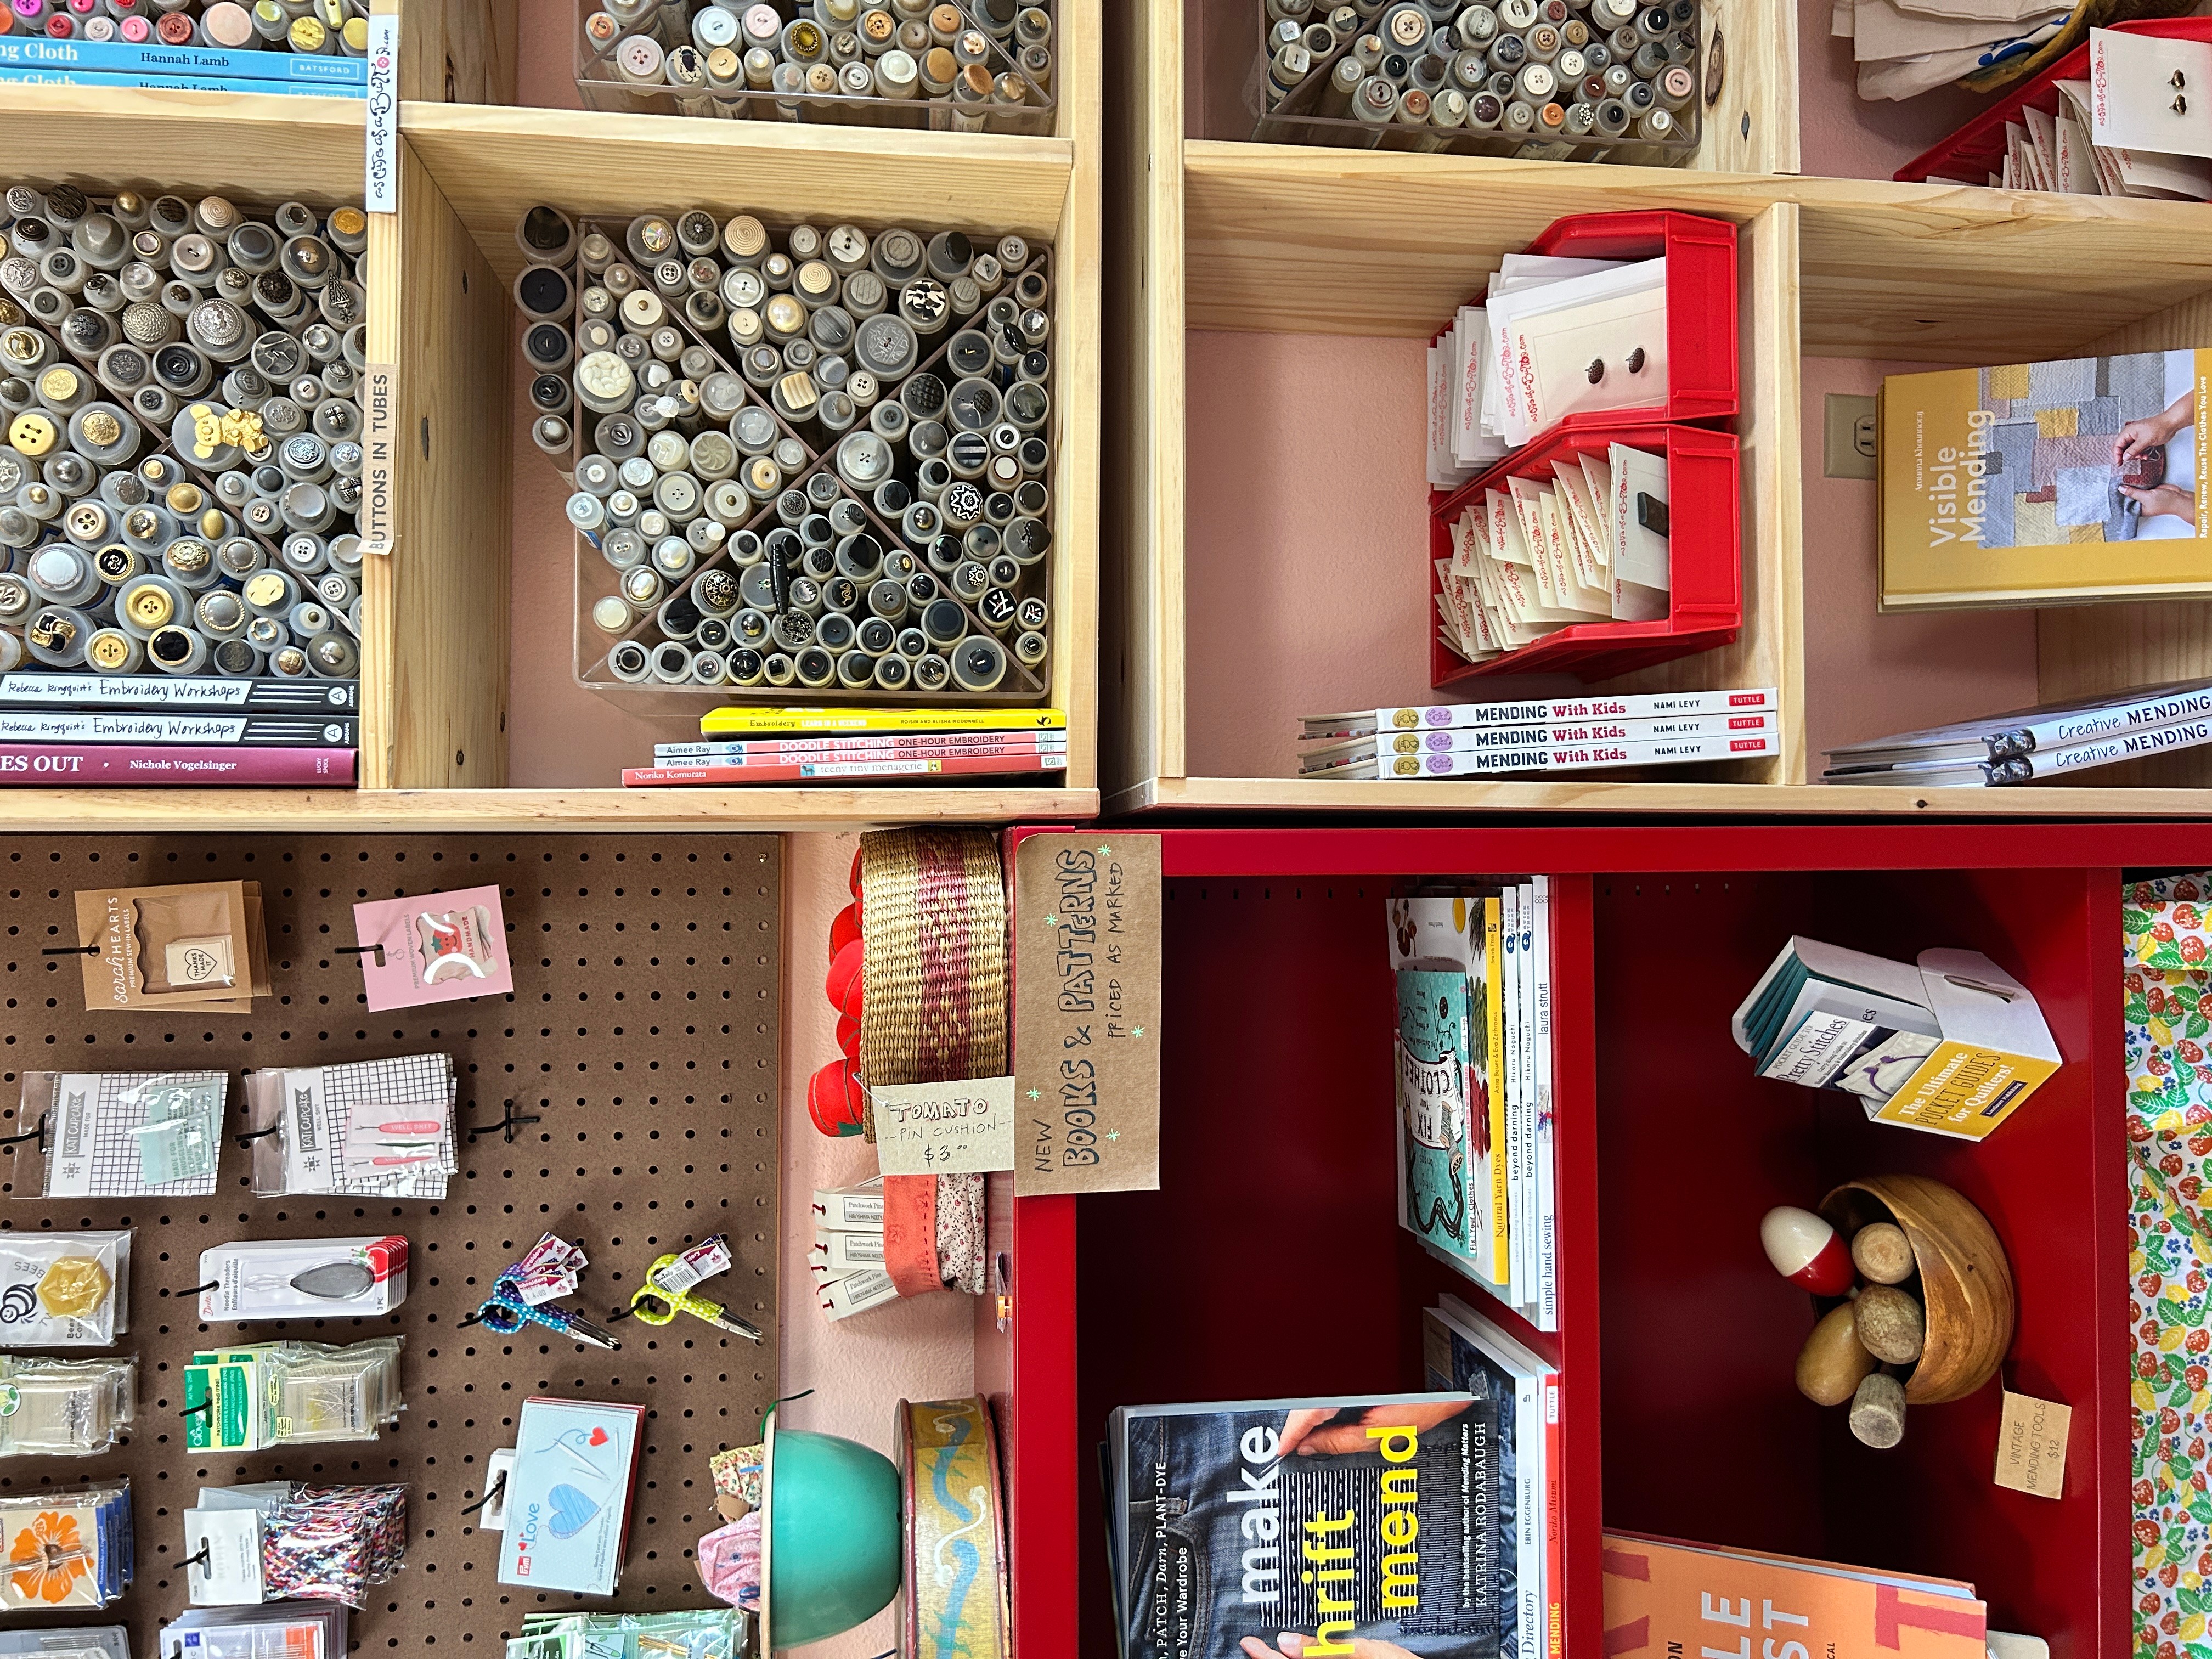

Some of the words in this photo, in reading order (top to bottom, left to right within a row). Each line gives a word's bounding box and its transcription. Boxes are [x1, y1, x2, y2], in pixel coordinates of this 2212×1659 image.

[140, 52, 190, 65] Hannah
[194, 55, 229, 66] Lamb
[299, 64, 350, 74] BATSFORD
[2199, 375, 2207, 394] Love
[373, 374, 388, 432] TUBES
[2199, 396, 2207, 410] You
[2199, 411, 2207, 440] Clothes
[373, 442, 387, 460] IN
[2199, 442, 2207, 455] The
[1959, 410, 1995, 541] Mending
[2199, 458, 2207, 480] Reuse
[369, 469, 387, 549] BUTTONS
[1928, 447, 1956, 548] Visible
[2199, 482, 2208, 509] Renew,
[2199, 511, 2207, 539] Repair,
[8, 681, 43, 693] Rebecca
[99, 679, 169, 701] Embroidery
[174, 683, 240, 701] Workshops
[1733, 696, 1760, 704] TUTTLE
[1476, 705, 1547, 721] MENDING
[1552, 704, 1588, 717] With
[1592, 702, 1626, 715] Kids
[2059, 717, 2121, 739] Creative
[2126, 696, 2211, 725] MENDING
[1, 720, 36, 732] Rebecca
[93, 718, 163, 739] Embroidery
[168, 720, 235, 739] Workshops
[780, 742, 830, 751] DOODLE
[834, 738, 895, 751] STITCHING
[898, 736, 946, 746] ONE-HOUR
[949, 735, 1005, 745] EMBROIDERY
[1476, 730, 1547, 746] MENDING
[1552, 728, 1588, 741] With
[1592, 726, 1626, 739] Kids
[696, 746, 711, 754] Ray
[780, 754, 830, 764] DOODLE
[834, 749, 895, 762] STITCHING
[898, 748, 946, 758] ONE-HOUR
[949, 746, 1005, 757] EMBROIDERY
[2056, 745, 2118, 767] Creative
[2123, 724, 2208, 753] MENDING
[33, 755, 83, 772] OUT
[129, 760, 171, 770] Nichole
[174, 760, 237, 771] Vogelsinger
[666, 771, 707, 779] Komurata
[696, 758, 710, 767] Ray
[821, 766, 847, 775] teeny
[850, 764, 870, 775] tiny
[872, 763, 922, 773] menagerie
[1108, 862, 1125, 933] MARKED
[108, 897, 122, 954] HEARTS
[462, 916, 475, 958] HANDMADE
[406, 936, 415, 959] WOVEN
[1108, 944, 1122, 964] AS
[105, 957, 128, 1003] sarah
[410, 961, 420, 989] PREMIUM
[1538, 983, 1548, 1007] strutt
[1063, 1024, 1092, 1048] &
[1538, 1011, 1549, 1035] laura
[1776, 1054, 1820, 1082] Pretty
[1799, 1019, 1847, 1056] Stitches
[1898, 1098, 1926, 1115] The
[1917, 1053, 1968, 1096] Ultimate
[1914, 1088, 1966, 1126] POCKET
[1950, 1053, 2001, 1088] GUIDES
[1948, 1108, 1972, 1123] for
[1965, 1064, 2015, 1107] Quilters!
[890, 1098, 988, 1123] TOMATO
[1059, 1058, 1099, 1167] BOOKS
[1510, 1105, 1519, 1142] darning
[1524, 1102, 1533, 1139] darning
[1032, 1118, 1053, 1172] NEW
[1525, 1143, 1533, 1178] beyond
[1493, 1154, 1503, 1175] Dyes
[1510, 1146, 1519, 1181] beyond
[1494, 1178, 1503, 1200] Yarn
[1495, 1203, 1505, 1238] Natural
[1542, 1215, 1554, 1250] sewing
[1542, 1252, 1553, 1279] hand
[1542, 1282, 1555, 1316] simple
[2032, 1402, 2046, 1438] TOOLS
[1460, 1423, 1469, 1456] Matters
[2010, 1420, 2024, 1465] VINTAGE
[2047, 1440, 2059, 1459] $12
[1461, 1458, 1471, 1493] Mending
[1474, 1423, 1487, 1526] RODABAUGH
[2027, 1441, 2041, 1490] MENDING
[1156, 1461, 1167, 1538] PLANT-DYE
[1461, 1495, 1469, 1504] of
[1548, 1481, 1558, 1513] Misumi
[527, 1502, 540, 1543] Love
[1227, 1425, 1280, 1604] make
[1366, 1424, 1418, 1610] mend
[1462, 1505, 1470, 1534] author
[1549, 1516, 1559, 1545] Noriko
[519, 1558, 531, 1575] Prym
[1156, 1543, 1169, 1583] Darn,
[1462, 1536, 1471, 1580] bestselling
[1476, 1532, 1487, 1608] KATRINA
[1176, 1547, 1187, 1613] Wardrobe
[1302, 1509, 1355, 1656] hrift
[1156, 1587, 1169, 1648] PATCH,
[1462, 1597, 1471, 1608] by
[1177, 1616, 1187, 1646] Your
[1521, 1590, 1537, 1655] Directory
[1549, 1602, 1560, 1655] MENDING
